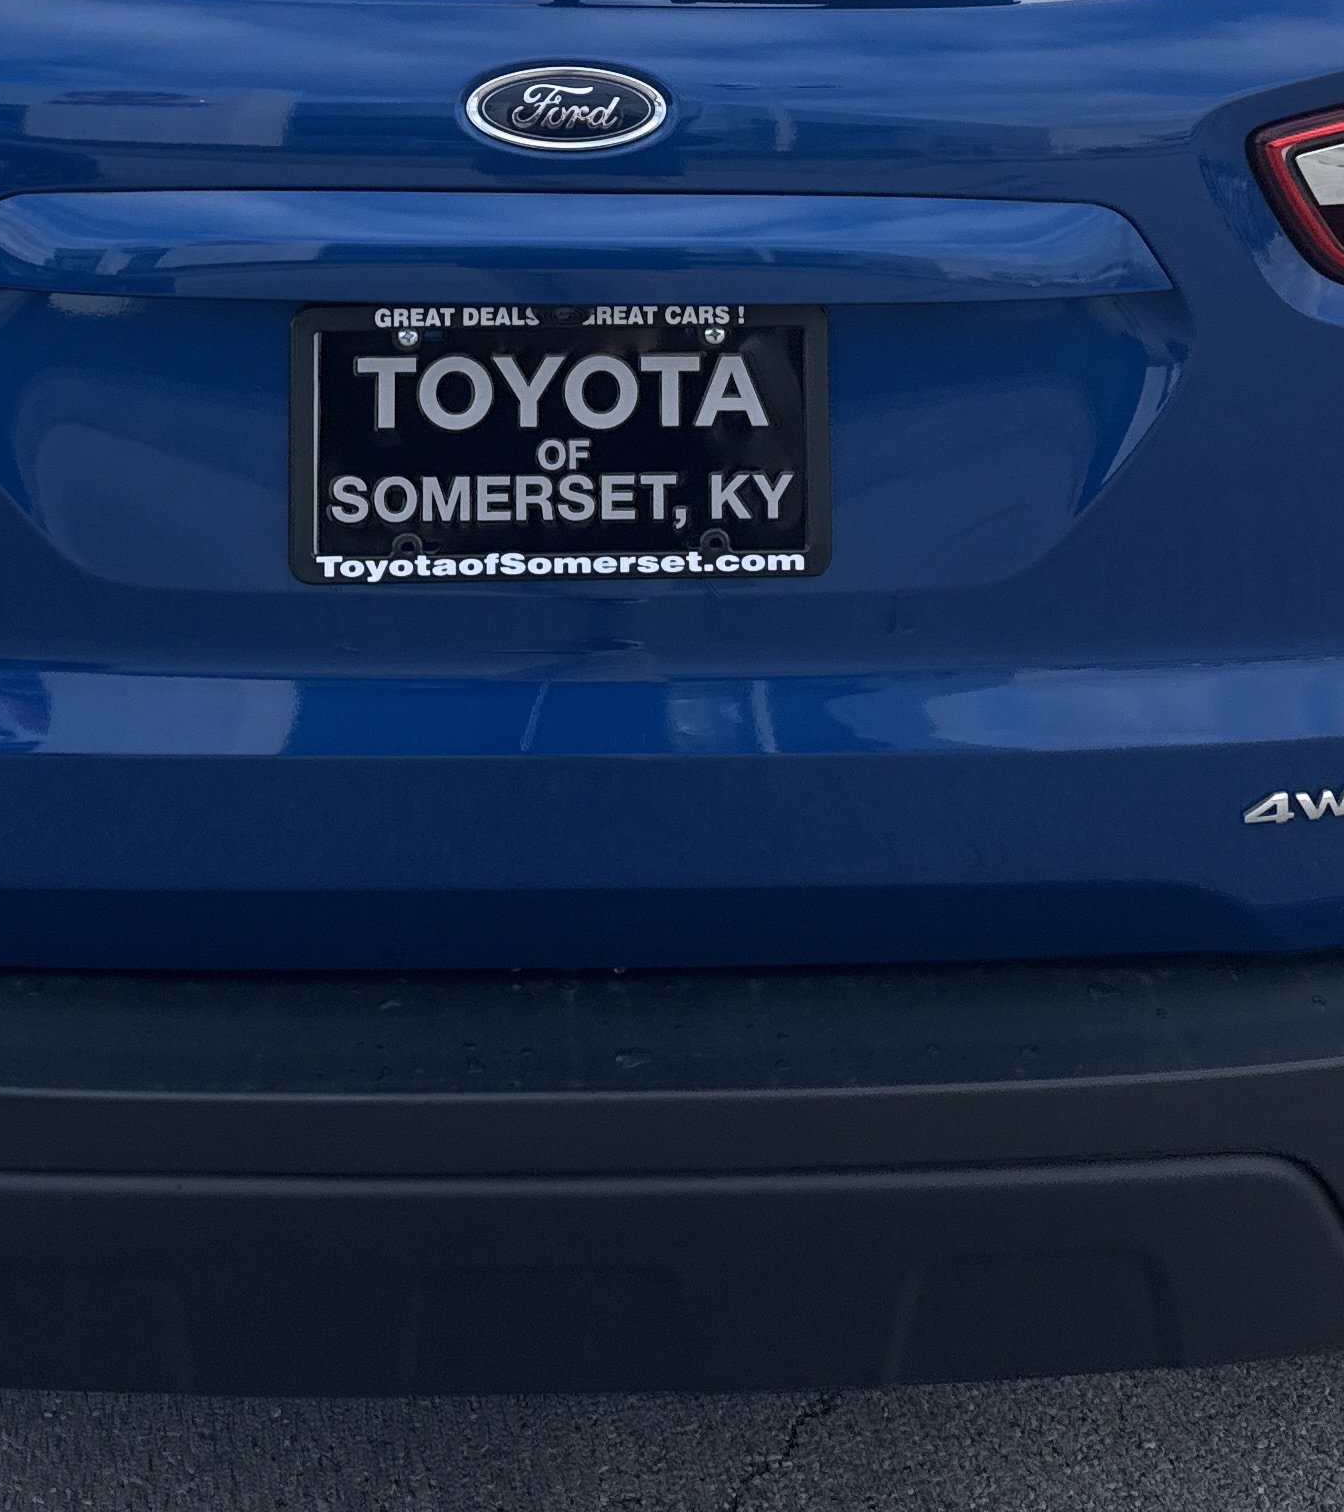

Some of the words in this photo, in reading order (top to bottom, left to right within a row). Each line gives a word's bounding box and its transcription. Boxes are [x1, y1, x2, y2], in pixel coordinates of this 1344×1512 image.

[512, 83, 621, 129] Ford
[375, 308, 455, 327] GREAT
[665, 306, 730, 325] CARS
[357, 354, 768, 431] TOYOTA
[537, 439, 591, 471] OF
[331, 475, 687, 529] SOMERSET,
[709, 473, 794, 520] KY
[315, 551, 806, 583] ToyotaofSomerset.com
